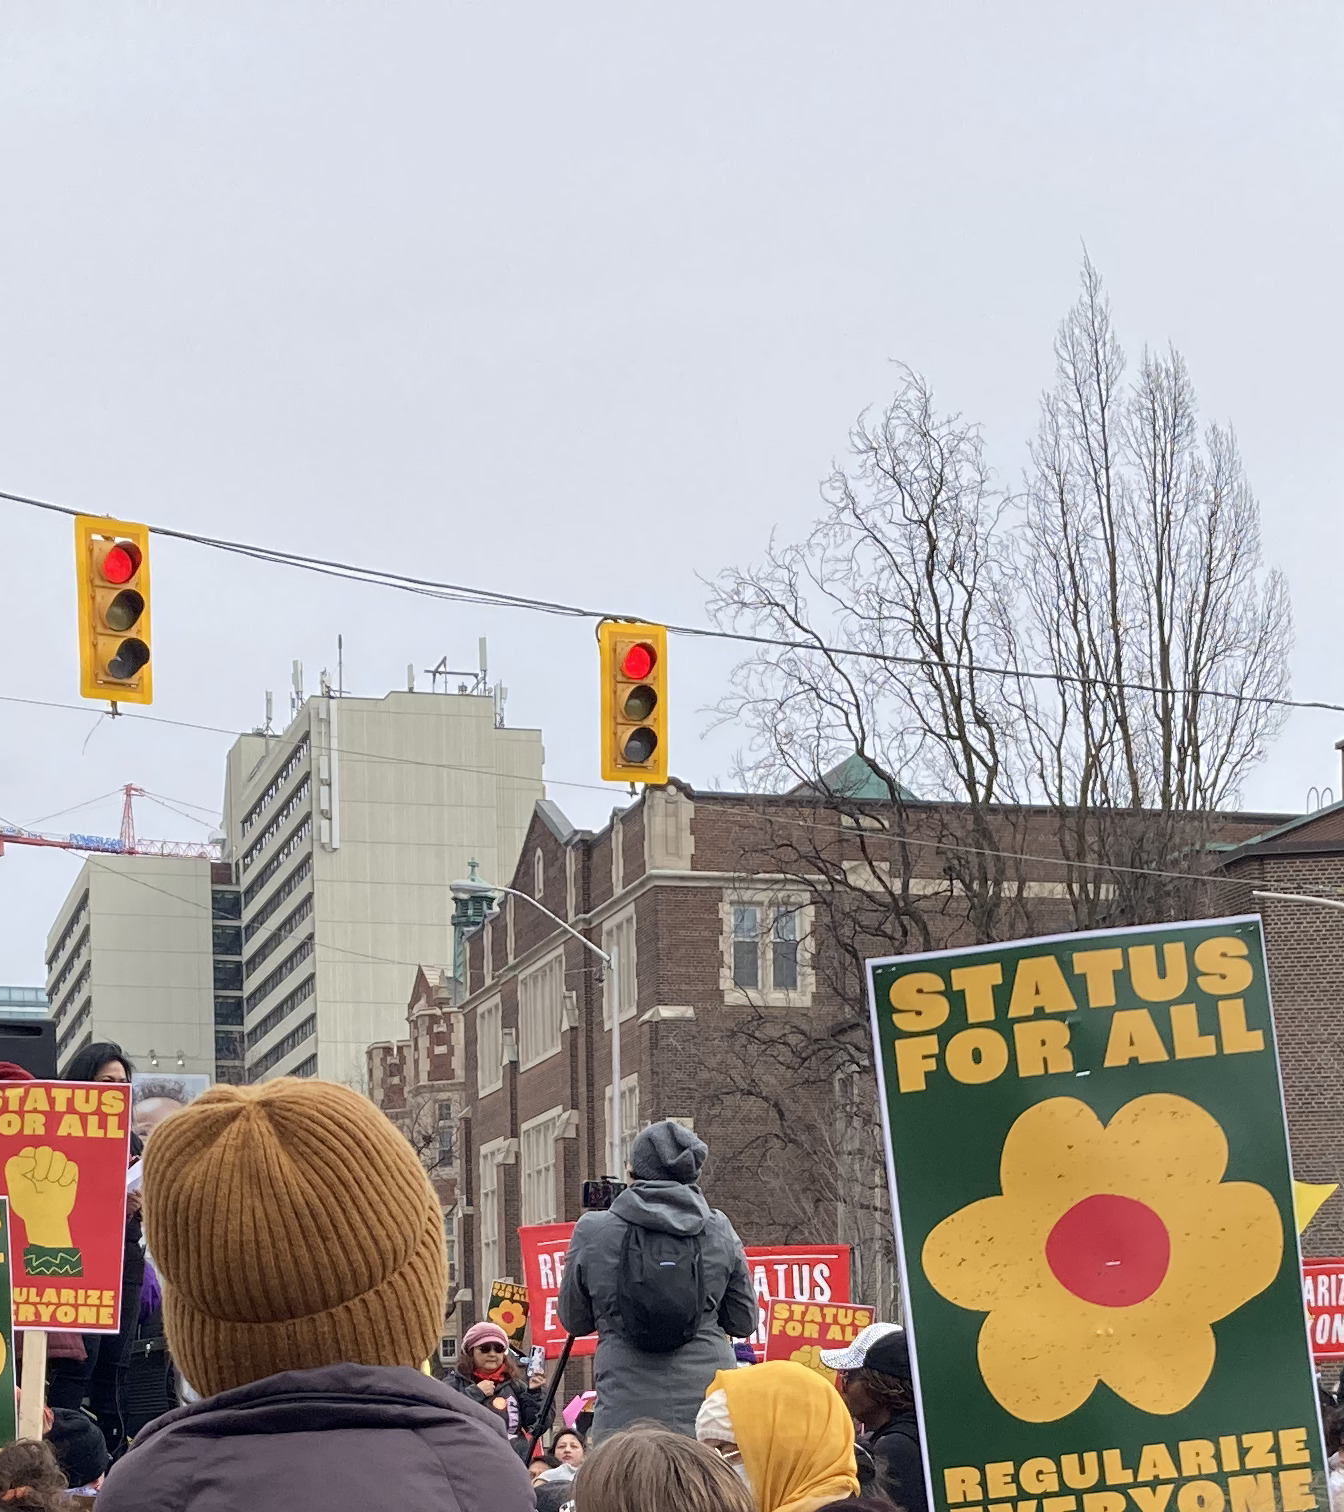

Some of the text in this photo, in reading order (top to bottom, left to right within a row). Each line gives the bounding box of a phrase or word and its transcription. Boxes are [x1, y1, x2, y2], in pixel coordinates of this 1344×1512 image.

[889, 937, 1254, 1033] STATUS
[894, 998, 1265, 1094] FOR ALL
[57, 1113, 125, 1139] ALL
[753, 1263, 832, 1302] ATUS
[13, 1286, 115, 1306] ULARIZE
[14, 1303, 114, 1325] RYONE
[773, 1303, 870, 1327] STATUS
[772, 1319, 819, 1339] FOR
[943, 1427, 1311, 1504] REGULARIZE
